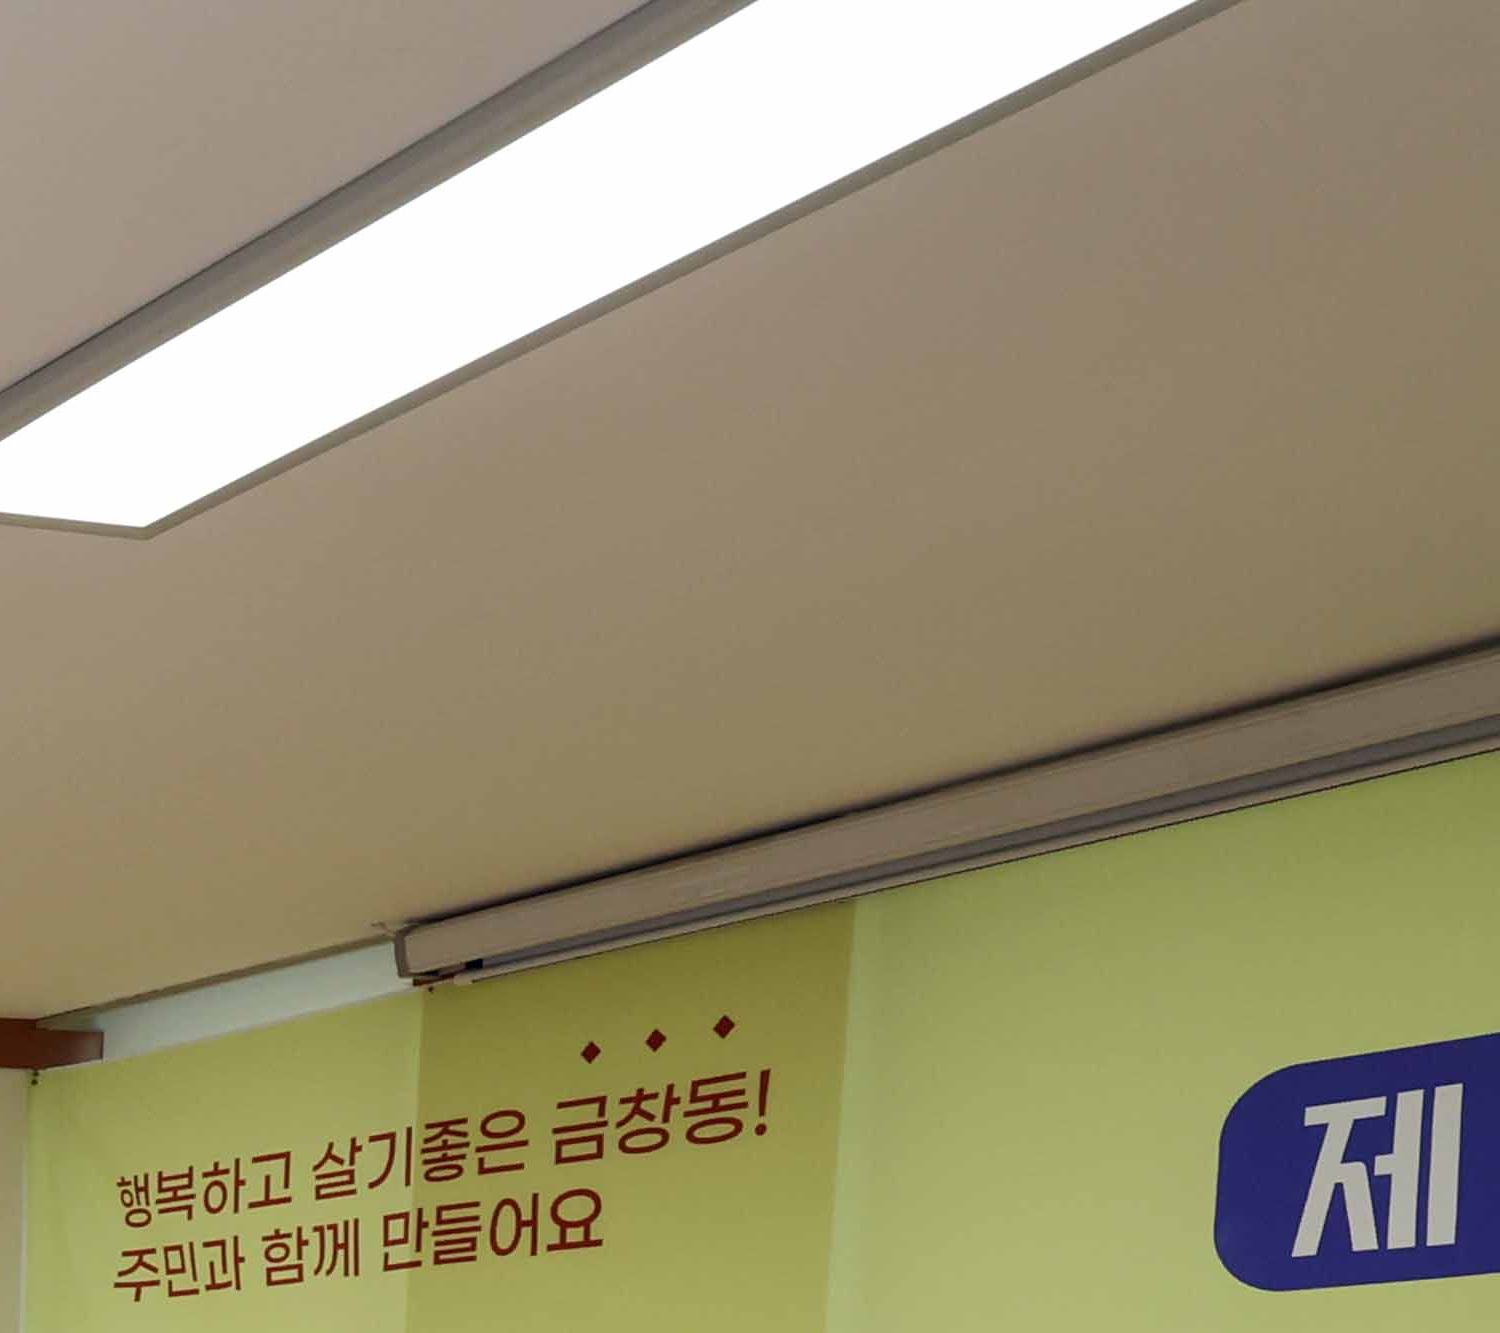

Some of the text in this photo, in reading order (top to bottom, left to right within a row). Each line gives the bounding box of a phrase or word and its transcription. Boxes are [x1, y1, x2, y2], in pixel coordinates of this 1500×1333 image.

[116, 1068, 772, 1229] 행복하고 살기좋은 금창동!
[1291, 1084, 1463, 1259] 제
[113, 1187, 605, 1302] 주민과 함께 만들어요
